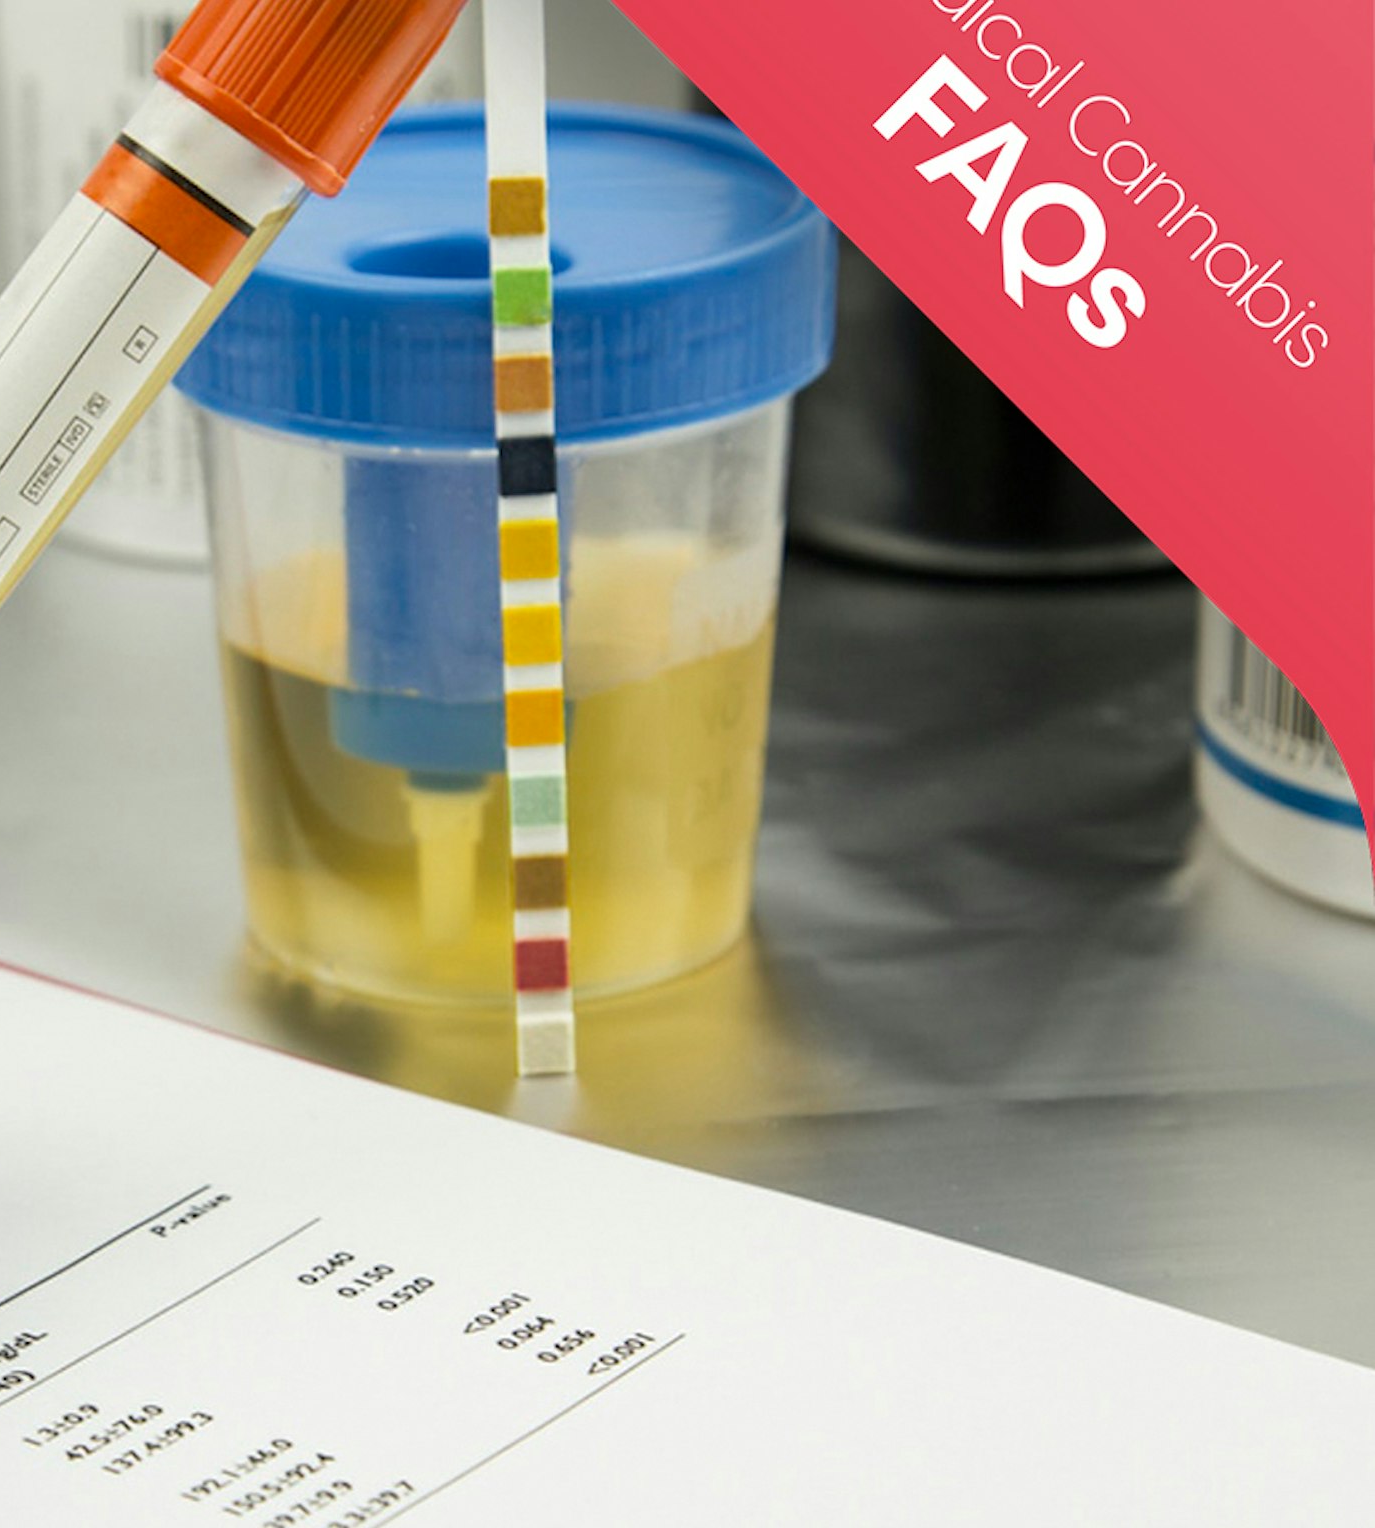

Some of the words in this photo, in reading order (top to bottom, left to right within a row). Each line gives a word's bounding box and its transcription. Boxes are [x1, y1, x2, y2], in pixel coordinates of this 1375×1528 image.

[27, 455, 62, 498] STERILE
[150, 1193, 232, 1238] P-value
[298, 1251, 355, 1287] 0.240
[337, 1264, 395, 1300] 0.150
[377, 1276, 436, 1313] 0.520
[463, 1292, 531, 1336] <0.001
[497, 1315, 556, 1351] 0.064
[537, 1328, 596, 1364] 0.656
[587, 1332, 656, 1376] <0.001
